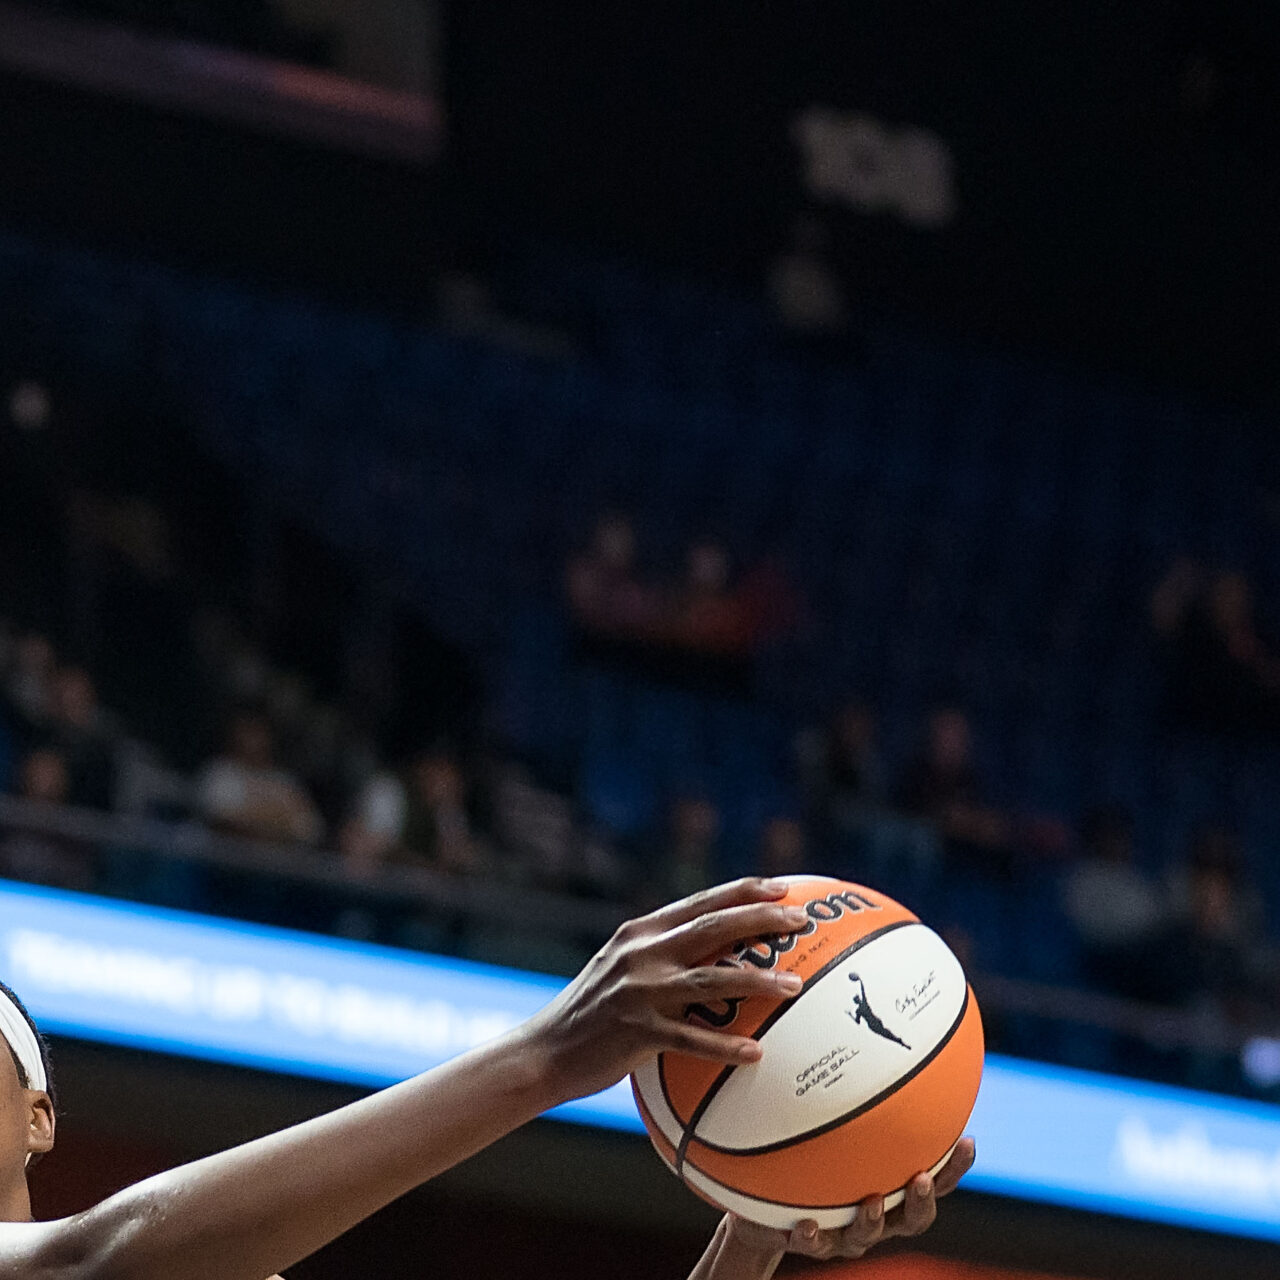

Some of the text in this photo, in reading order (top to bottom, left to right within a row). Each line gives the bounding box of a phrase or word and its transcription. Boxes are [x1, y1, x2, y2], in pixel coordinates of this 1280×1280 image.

[796, 1046, 847, 1082] OFFICIAL
[796, 1069, 829, 1096] GAME
[830, 1050, 860, 1072] BALL
